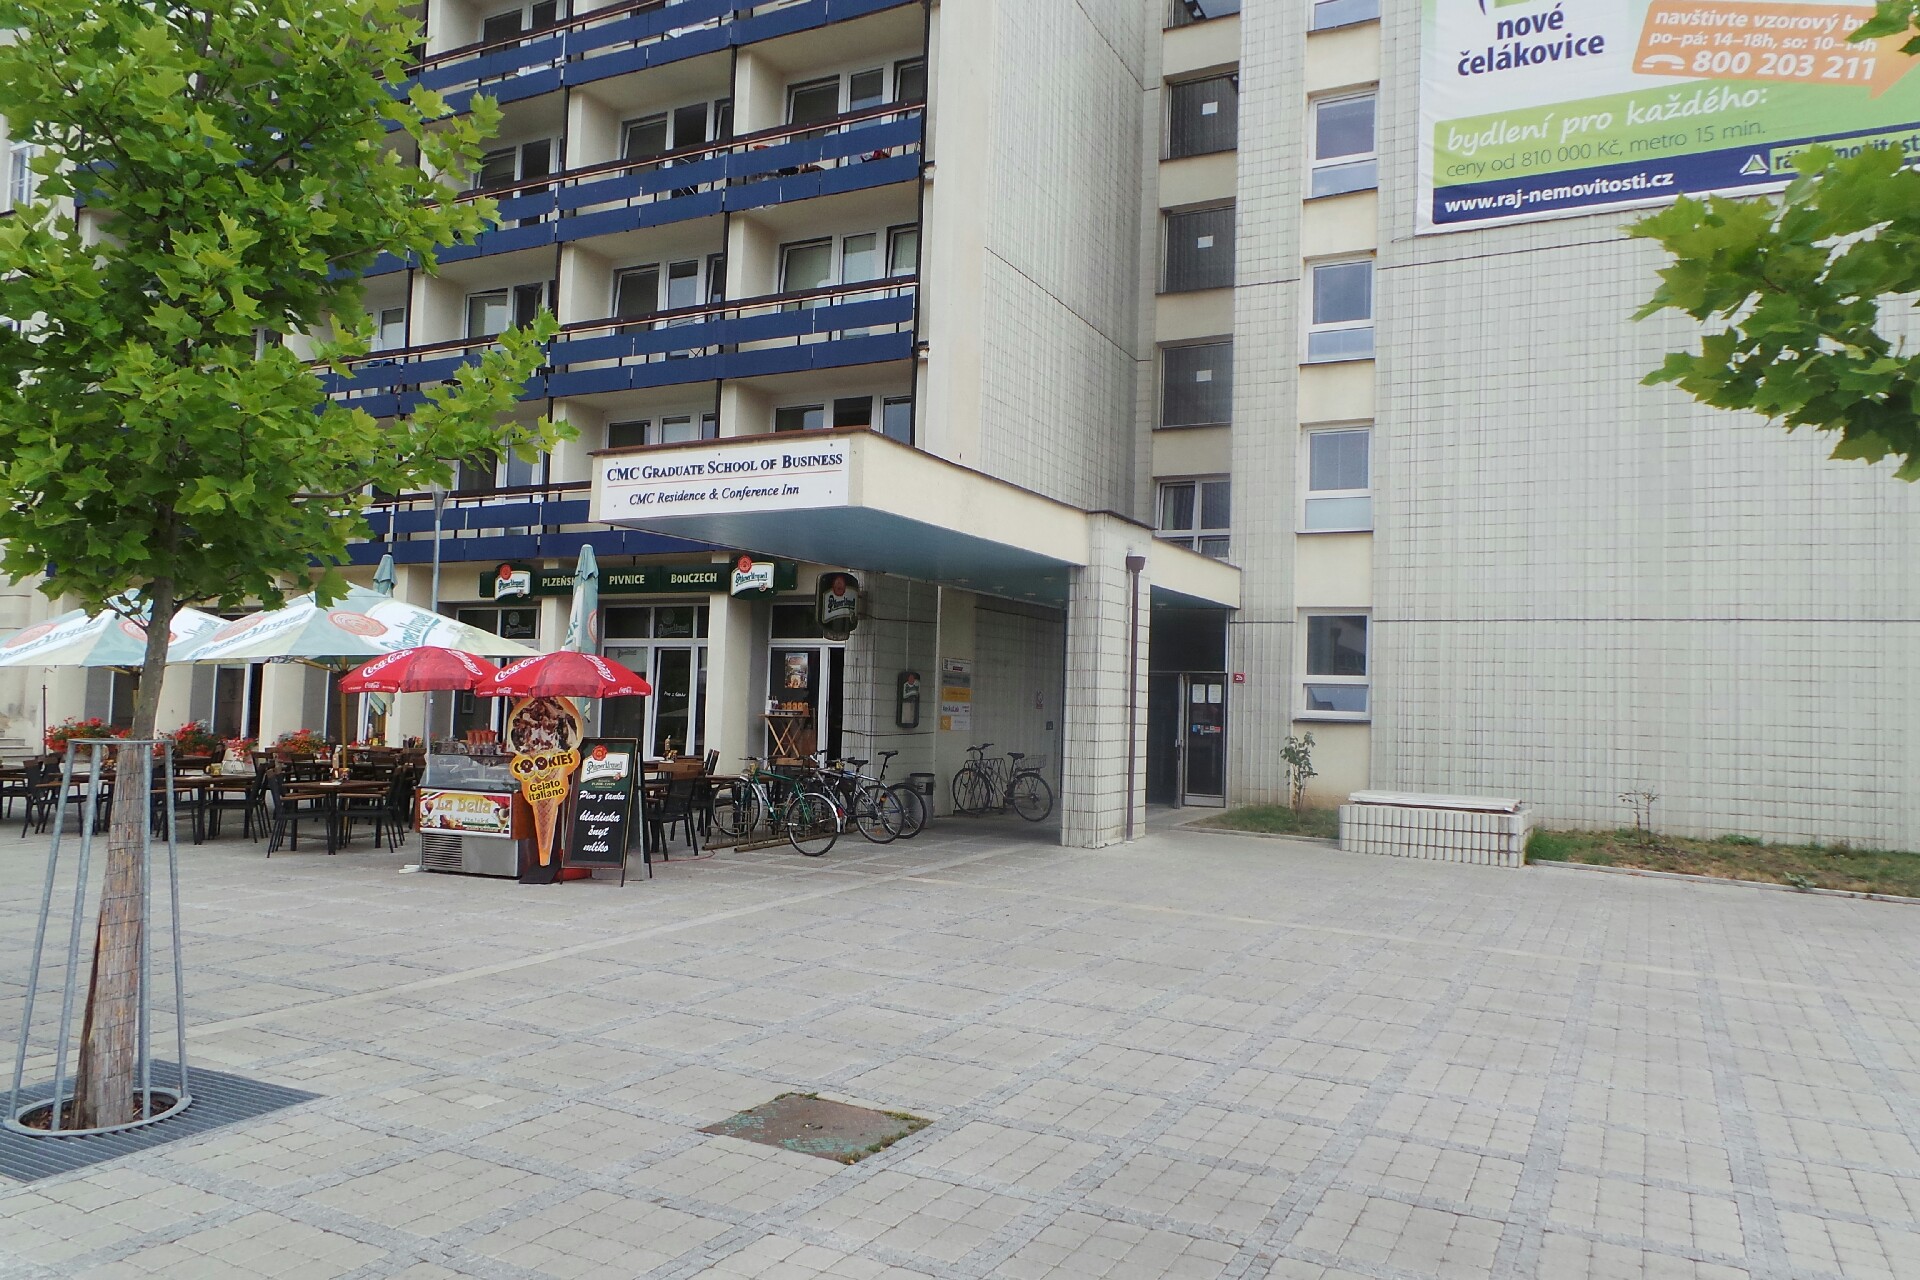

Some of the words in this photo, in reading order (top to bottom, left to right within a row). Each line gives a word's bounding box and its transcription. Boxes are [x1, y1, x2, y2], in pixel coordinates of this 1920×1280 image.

[1497, 2, 1564, 40] nové
[1655, 9, 1748, 28] navštivte
[1754, 14, 1839, 35] vzorový
[1782, 37, 1807, 49] so:
[1458, 33, 1605, 76] čelákovice
[1692, 50, 1751, 74] 800
[1756, 52, 1814, 77] 203
[1821, 55, 1877, 80] 211
[1447, 112, 1556, 156] bydlení
[1558, 110, 1613, 143] pro
[1626, 85, 1768, 126] každého:
[1446, 160, 1486, 179] ceny
[1491, 153, 1515, 172] od
[1522, 149, 1552, 168] 810
[1557, 146, 1591, 163] 000
[1597, 139, 1624, 158] Kč,
[1629, 131, 1687, 153] metro
[1696, 126, 1715, 144] 15
[1722, 119, 1767, 139] min.
[1444, 170, 1675, 214] www.raj-nemovitosti.cz
[607, 466, 640, 482] CMC
[629, 492, 654, 506] CMC
[657, 489, 706, 503] Residence
[709, 488, 719, 500] &
[721, 485, 779, 501] Conference
[781, 483, 800, 495] Inn
[609, 574, 645, 585] PIVNICE
[362, 648, 413, 678] Coca-Cola
[494, 655, 547, 682] Coca-Cola
[514, 754, 573, 774] COOKIES
[528, 788, 564, 801] italiano
[530, 780, 560, 792] Gelato
[579, 790, 597, 800] Pivo
[604, 791, 626, 800] tanku
[579, 809, 621, 823] hladinka
[588, 824, 610, 839] šnyt
[583, 841, 609, 852] mlíko
